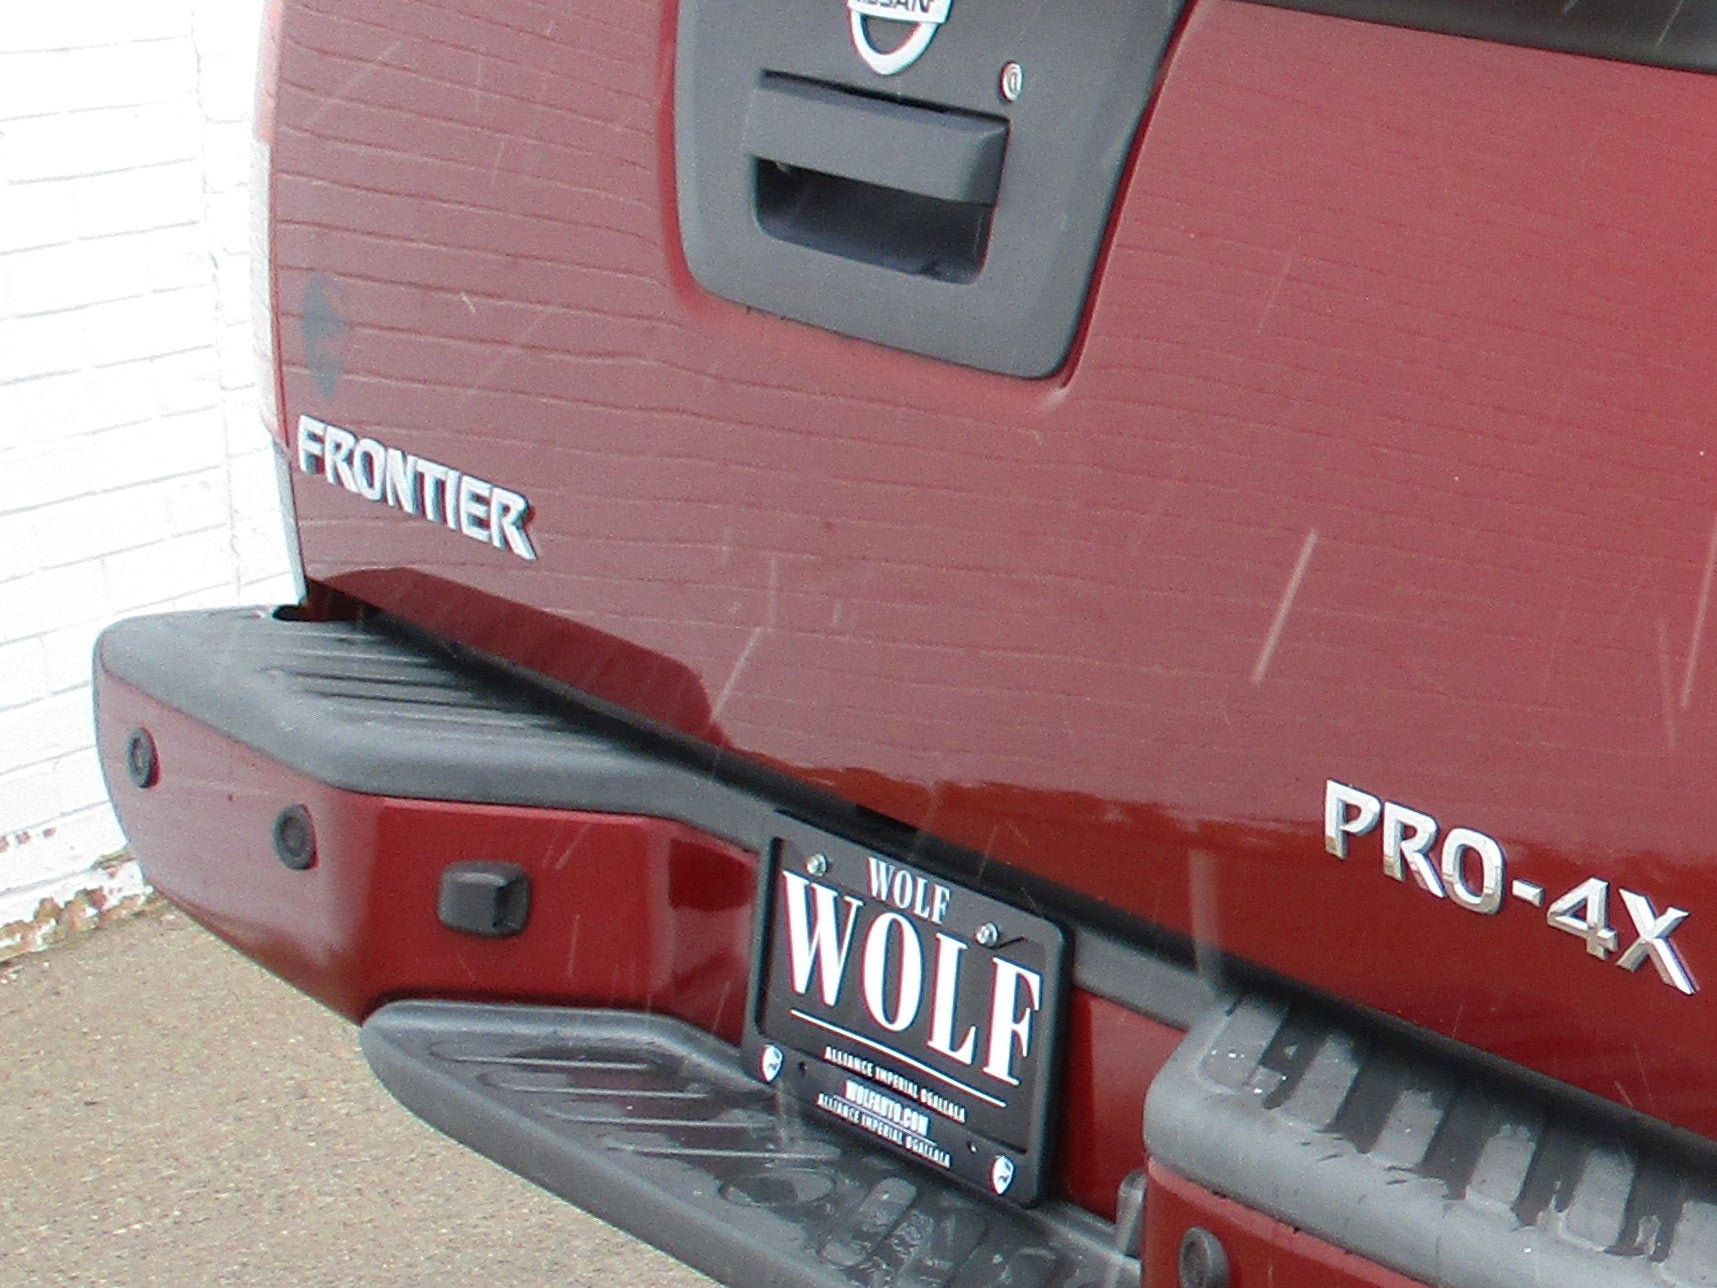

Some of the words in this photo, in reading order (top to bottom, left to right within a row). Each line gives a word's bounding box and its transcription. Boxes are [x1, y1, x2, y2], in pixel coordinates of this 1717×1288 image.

[297, 413, 538, 561] FRONTIER
[867, 855, 951, 925] WOLF
[1324, 778, 1700, 995] PRO-4X
[781, 869, 1043, 1086] WOLF
[824, 1046, 873, 1077] ALLIANCE
[875, 1066, 919, 1099] IMPERIAL
[817, 1093, 860, 1124] ALLIANCE
[861, 1113, 903, 1145] IMPERIAL
[845, 1079, 930, 1137] WOLFAUTO.COM
